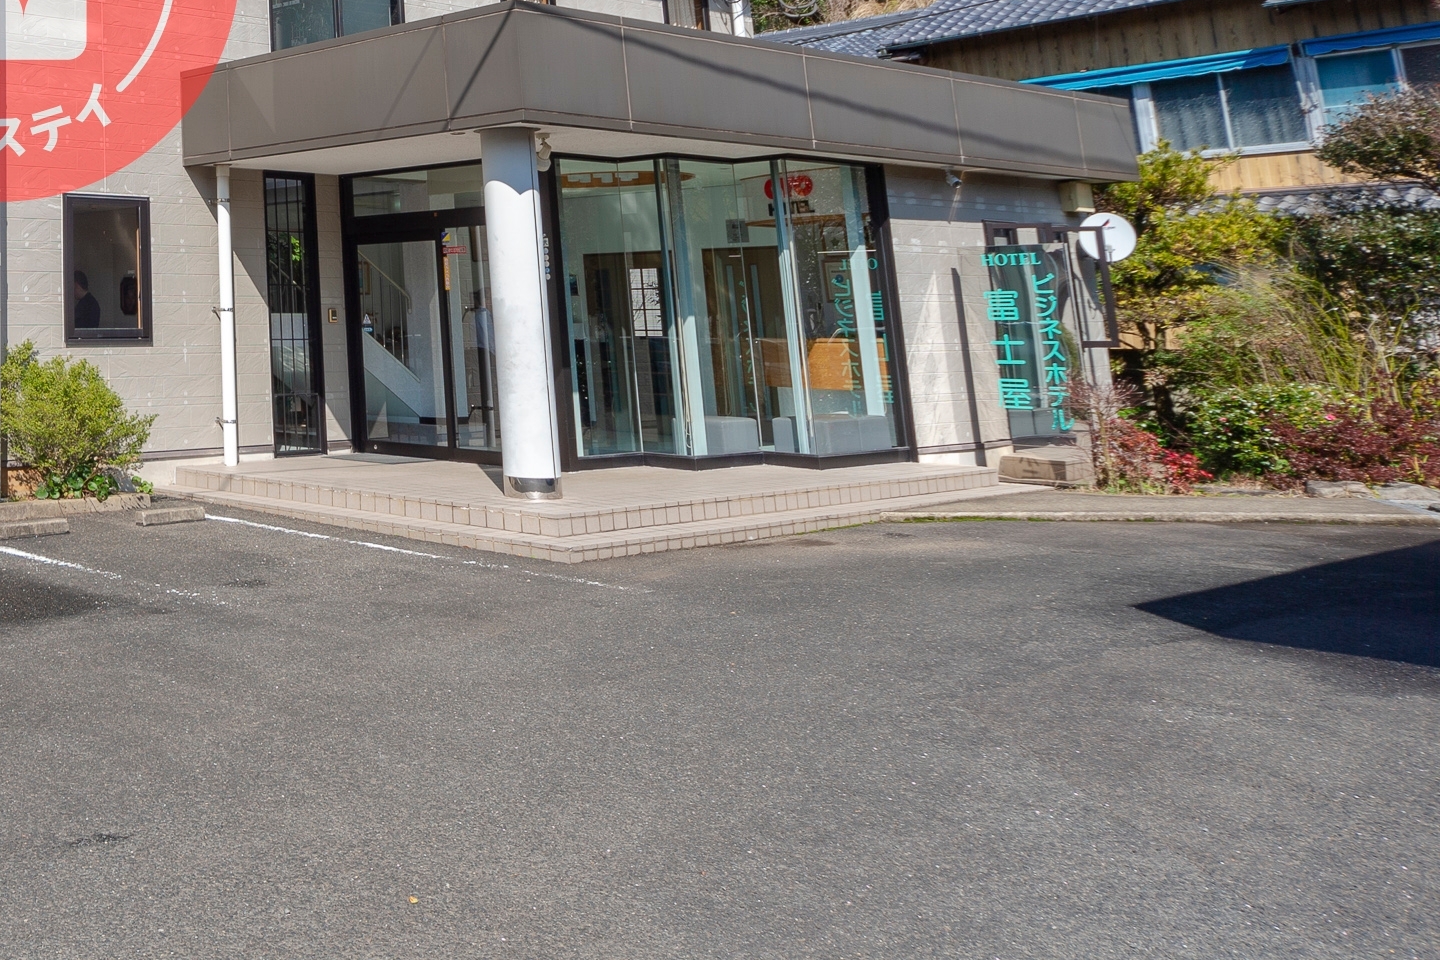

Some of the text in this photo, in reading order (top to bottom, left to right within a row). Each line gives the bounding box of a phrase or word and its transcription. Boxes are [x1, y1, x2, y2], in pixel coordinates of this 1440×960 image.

[767, 200, 815, 217] HTEL
[981, 252, 1041, 266] HOTEL
[983, 289, 1034, 410] 富士屋
[1031, 272, 1075, 431] ビジネスホテル
